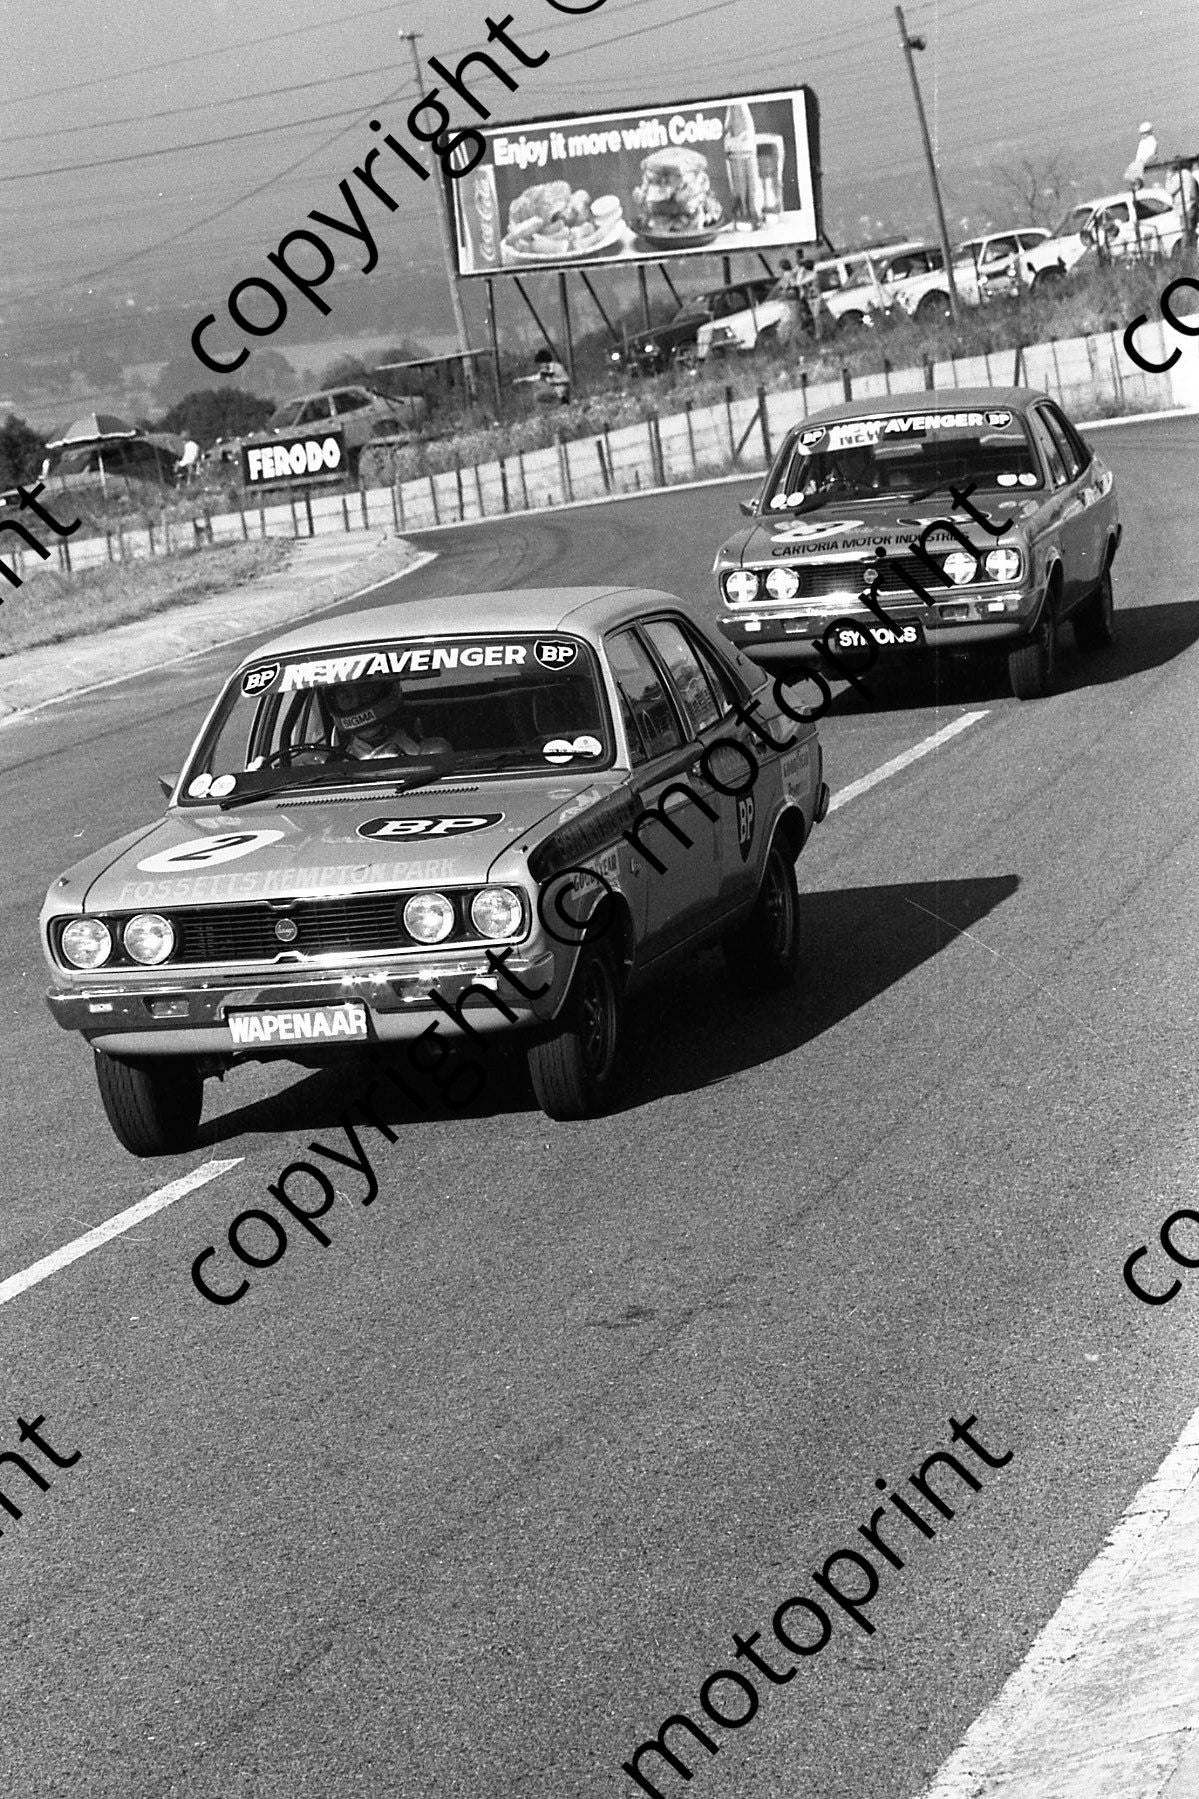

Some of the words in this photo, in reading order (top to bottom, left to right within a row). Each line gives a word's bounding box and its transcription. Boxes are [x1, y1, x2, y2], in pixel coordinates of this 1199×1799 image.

[493, 136, 549, 169] Enjoy
[549, 131, 567, 160] it
[567, 126, 622, 157] more
[622, 118, 669, 150] with
[668, 112, 724, 145] Coke
[884, 413, 983, 434] AVENGER
[247, 437, 341, 481] FERODO
[771, 538, 838, 557] CARTORIA
[841, 534, 892, 549] MOTOR
[895, 531, 969, 545] INDSTRI
[243, 669, 276, 691] BP
[366, 644, 527, 676] AVENGER
[540, 644, 575, 662] BP
[343, 711, 374, 727] SIGMA
[369, 813, 491, 836] BP
[168, 834, 254, 861] 2
[262, 864, 387, 893] KEMPTON
[391, 859, 456, 882] PARK
[228, 1008, 368, 1044] WAPENAAR
